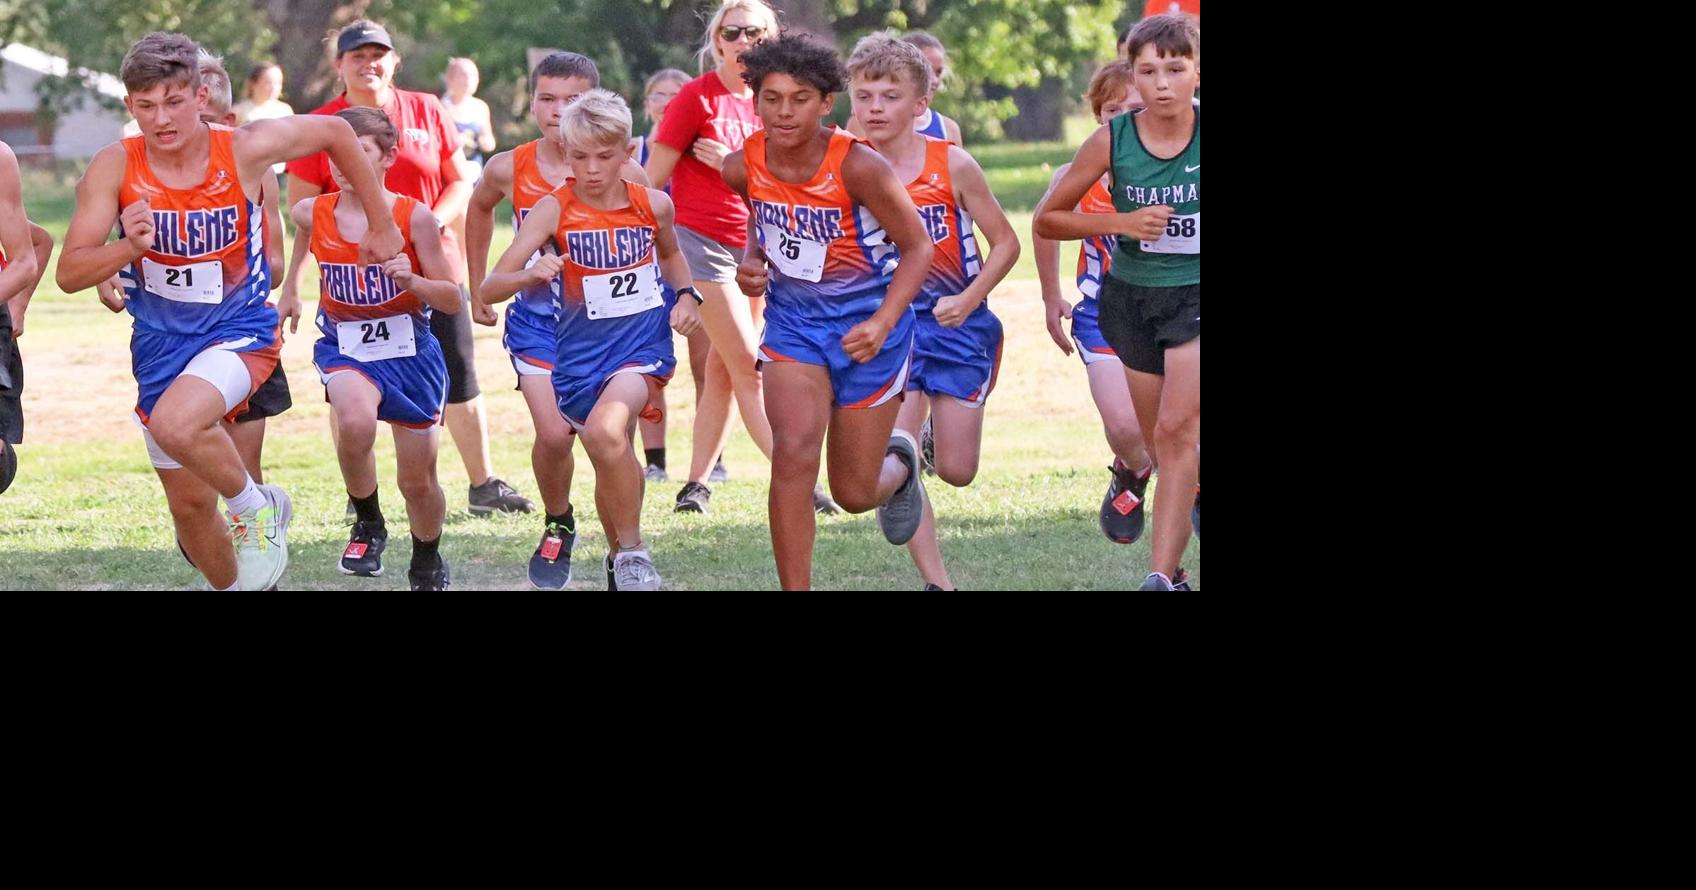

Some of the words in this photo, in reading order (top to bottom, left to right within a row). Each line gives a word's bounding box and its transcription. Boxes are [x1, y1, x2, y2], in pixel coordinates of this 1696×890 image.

[1126, 183, 1200, 205] CHAPMA
[1166, 216, 1196, 238] 58
[566, 226, 655, 270] ABILENE
[779, 232, 801, 261] 25
[165, 268, 193, 287] 21
[320, 262, 407, 306] ABILEN
[609, 272, 640, 299] 22
[360, 321, 390, 344] 24
